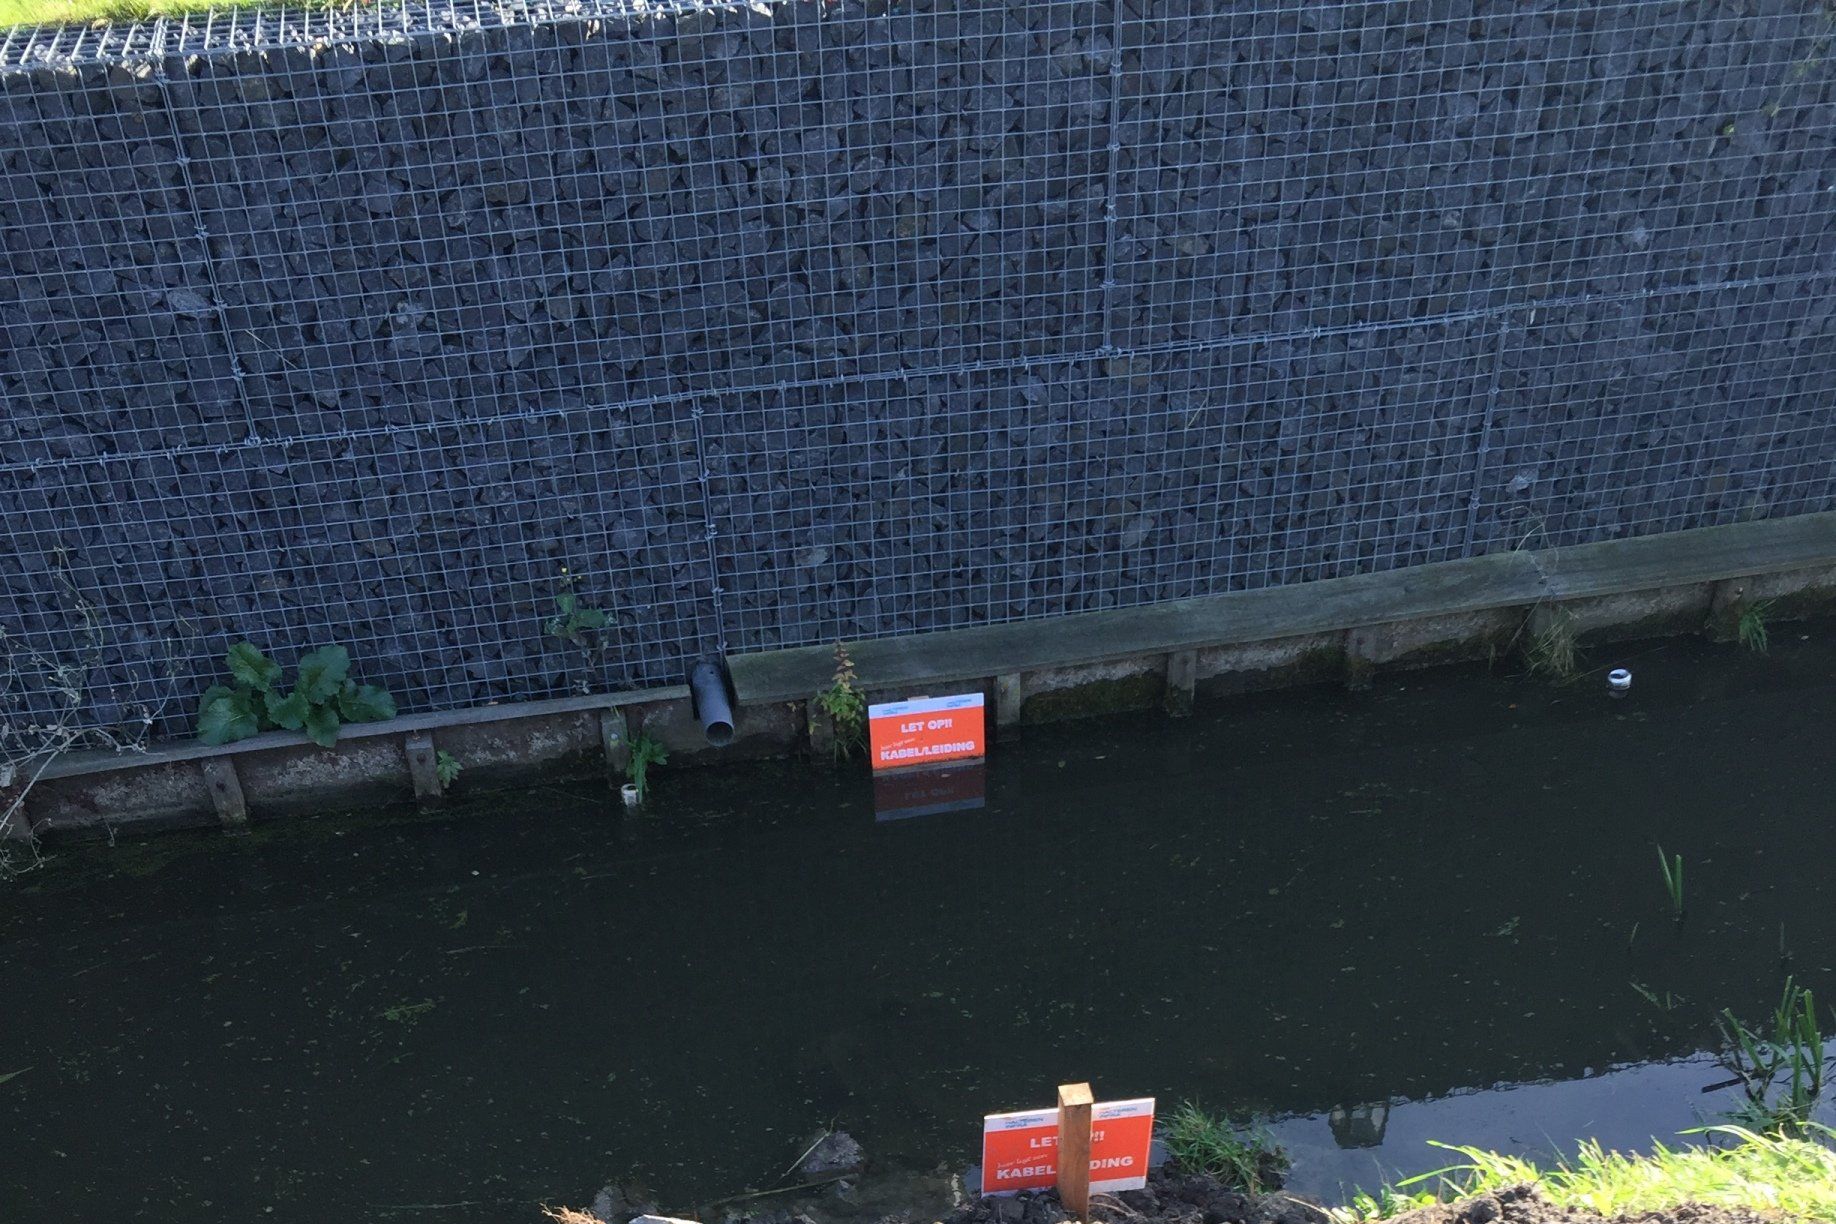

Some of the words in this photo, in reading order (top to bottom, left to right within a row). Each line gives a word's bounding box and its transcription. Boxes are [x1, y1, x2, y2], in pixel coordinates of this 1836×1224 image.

[901, 721, 924, 733] LET
[928, 719, 953, 730] OP!!
[880, 740, 975, 761] KABEL/LEIDING
